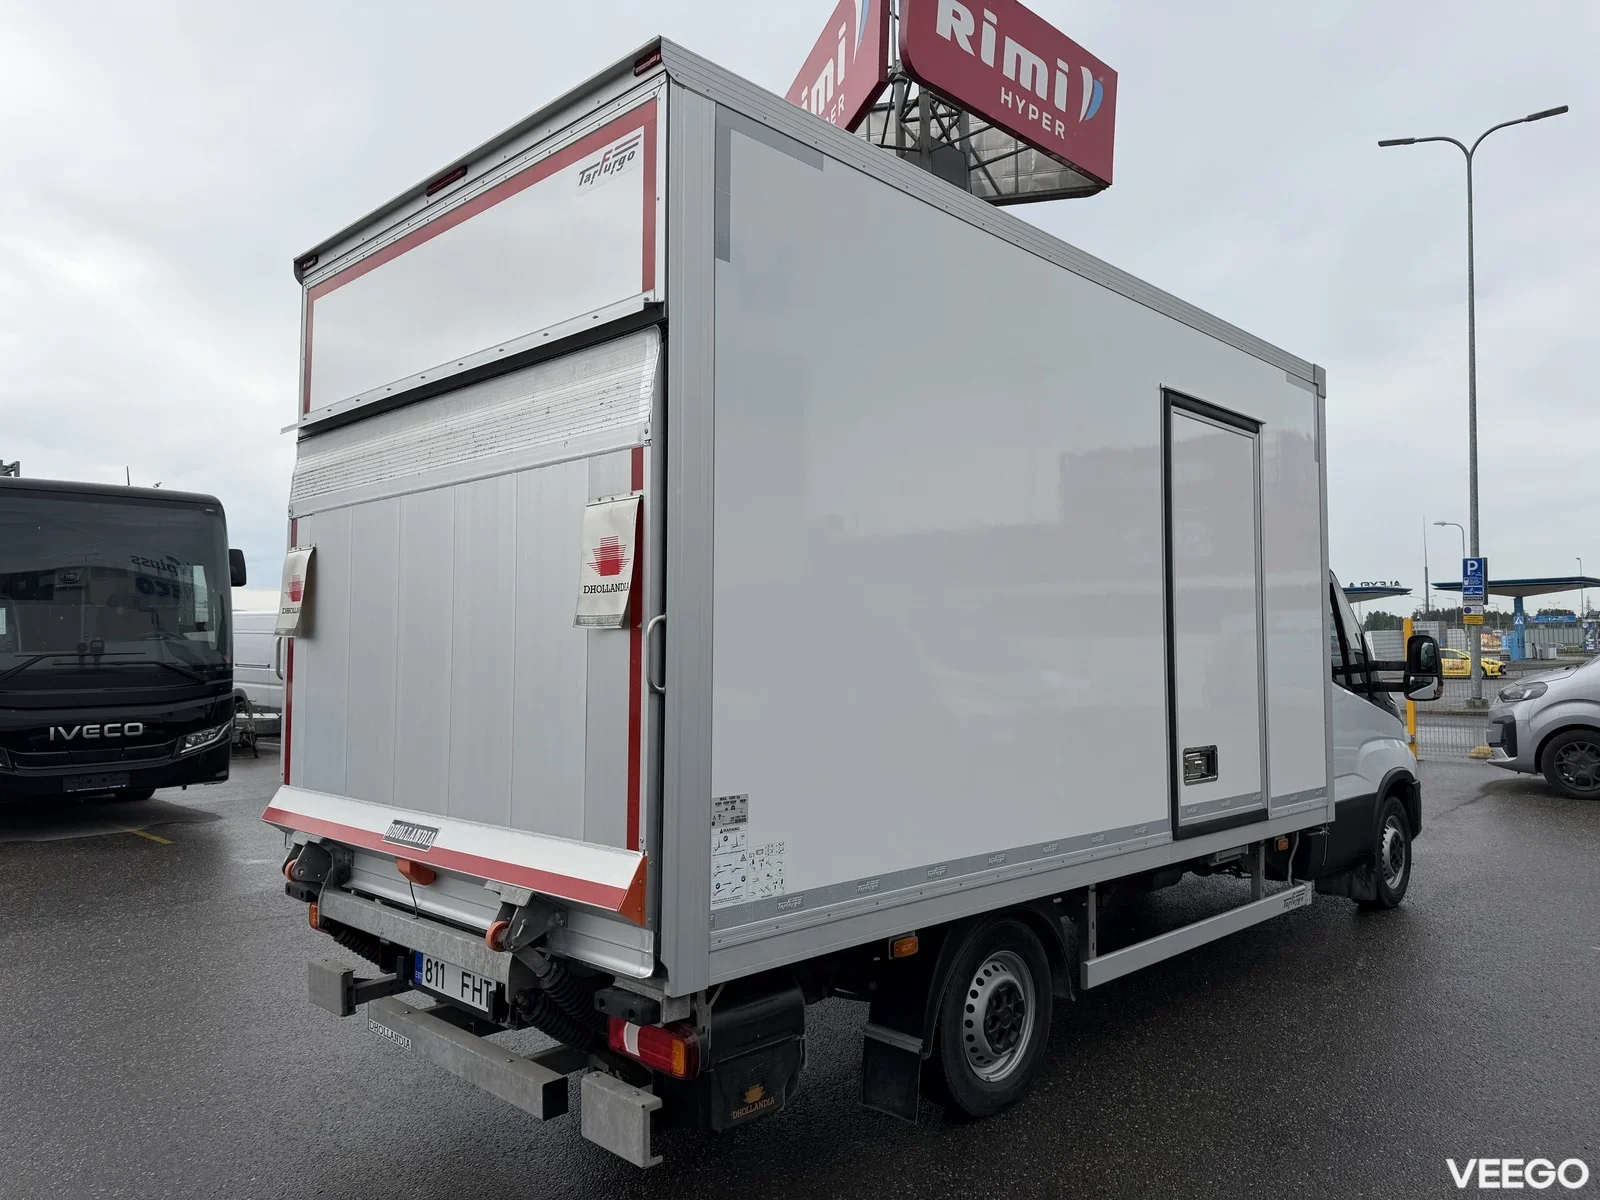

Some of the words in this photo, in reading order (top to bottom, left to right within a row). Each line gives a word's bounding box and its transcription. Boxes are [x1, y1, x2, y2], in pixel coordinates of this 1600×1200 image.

[936, 0, 1069, 113] Rimi
[1000, 86, 1066, 140] HYPER
[1467, 560, 1479, 576] P
[49, 722, 144, 741] IVECO
[385, 823, 438, 846] DHOLLANDIA
[425, 957, 445, 990] 811
[461, 970, 492, 1008] FHT
[369, 1020, 411, 1050] DHOLLANDIA
[732, 1096, 776, 1120] DHOLLANDIA
